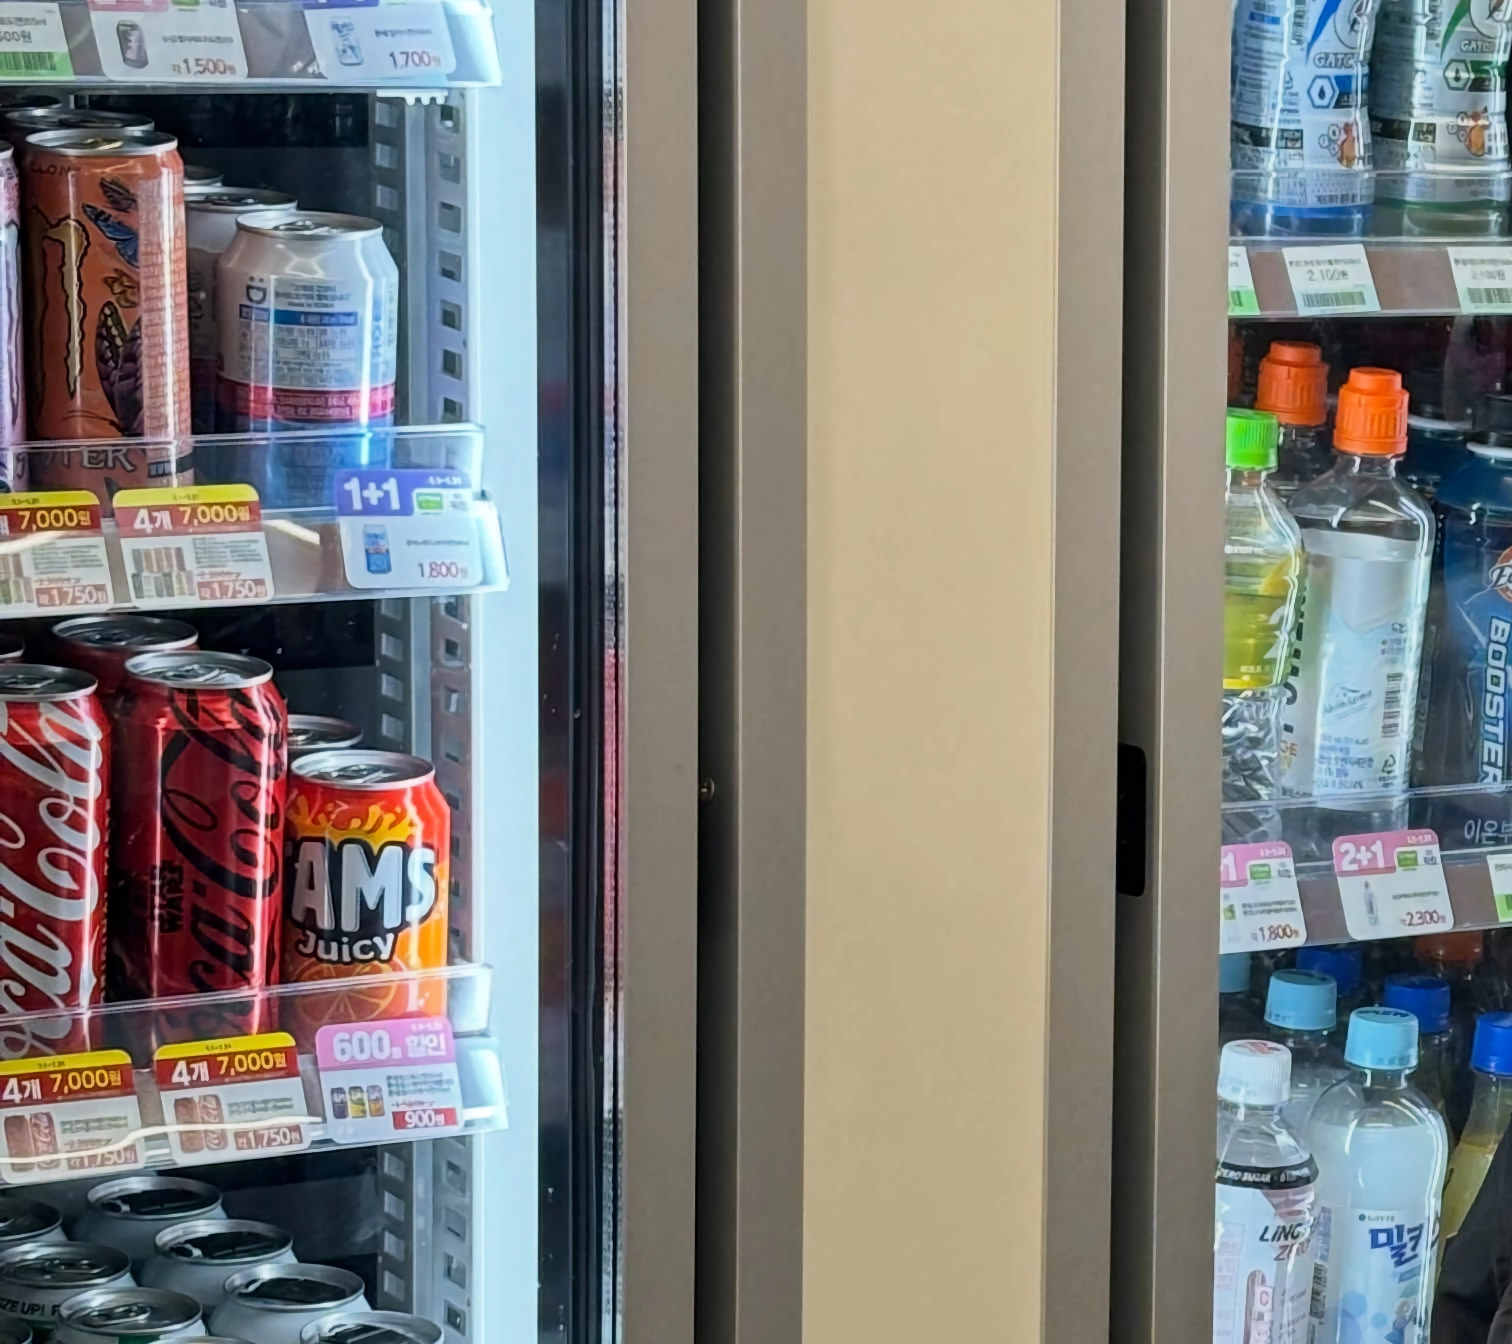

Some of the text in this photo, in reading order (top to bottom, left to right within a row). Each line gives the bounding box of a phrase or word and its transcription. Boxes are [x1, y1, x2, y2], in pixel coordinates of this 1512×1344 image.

[344, 477, 401, 511] 1+1
[18, 508, 91, 531] 7,000원
[133, 504, 250, 535] 4개 7,000원
[1479, 615, 1512, 793] BOOSTER
[1339, 841, 1386, 872] 2+1
[291, 841, 438, 933] AMS
[299, 930, 397, 963] Juicy
[2, 1069, 122, 1104] 4개 7,000원
[171, 1053, 287, 1087] 4개 7,000원
